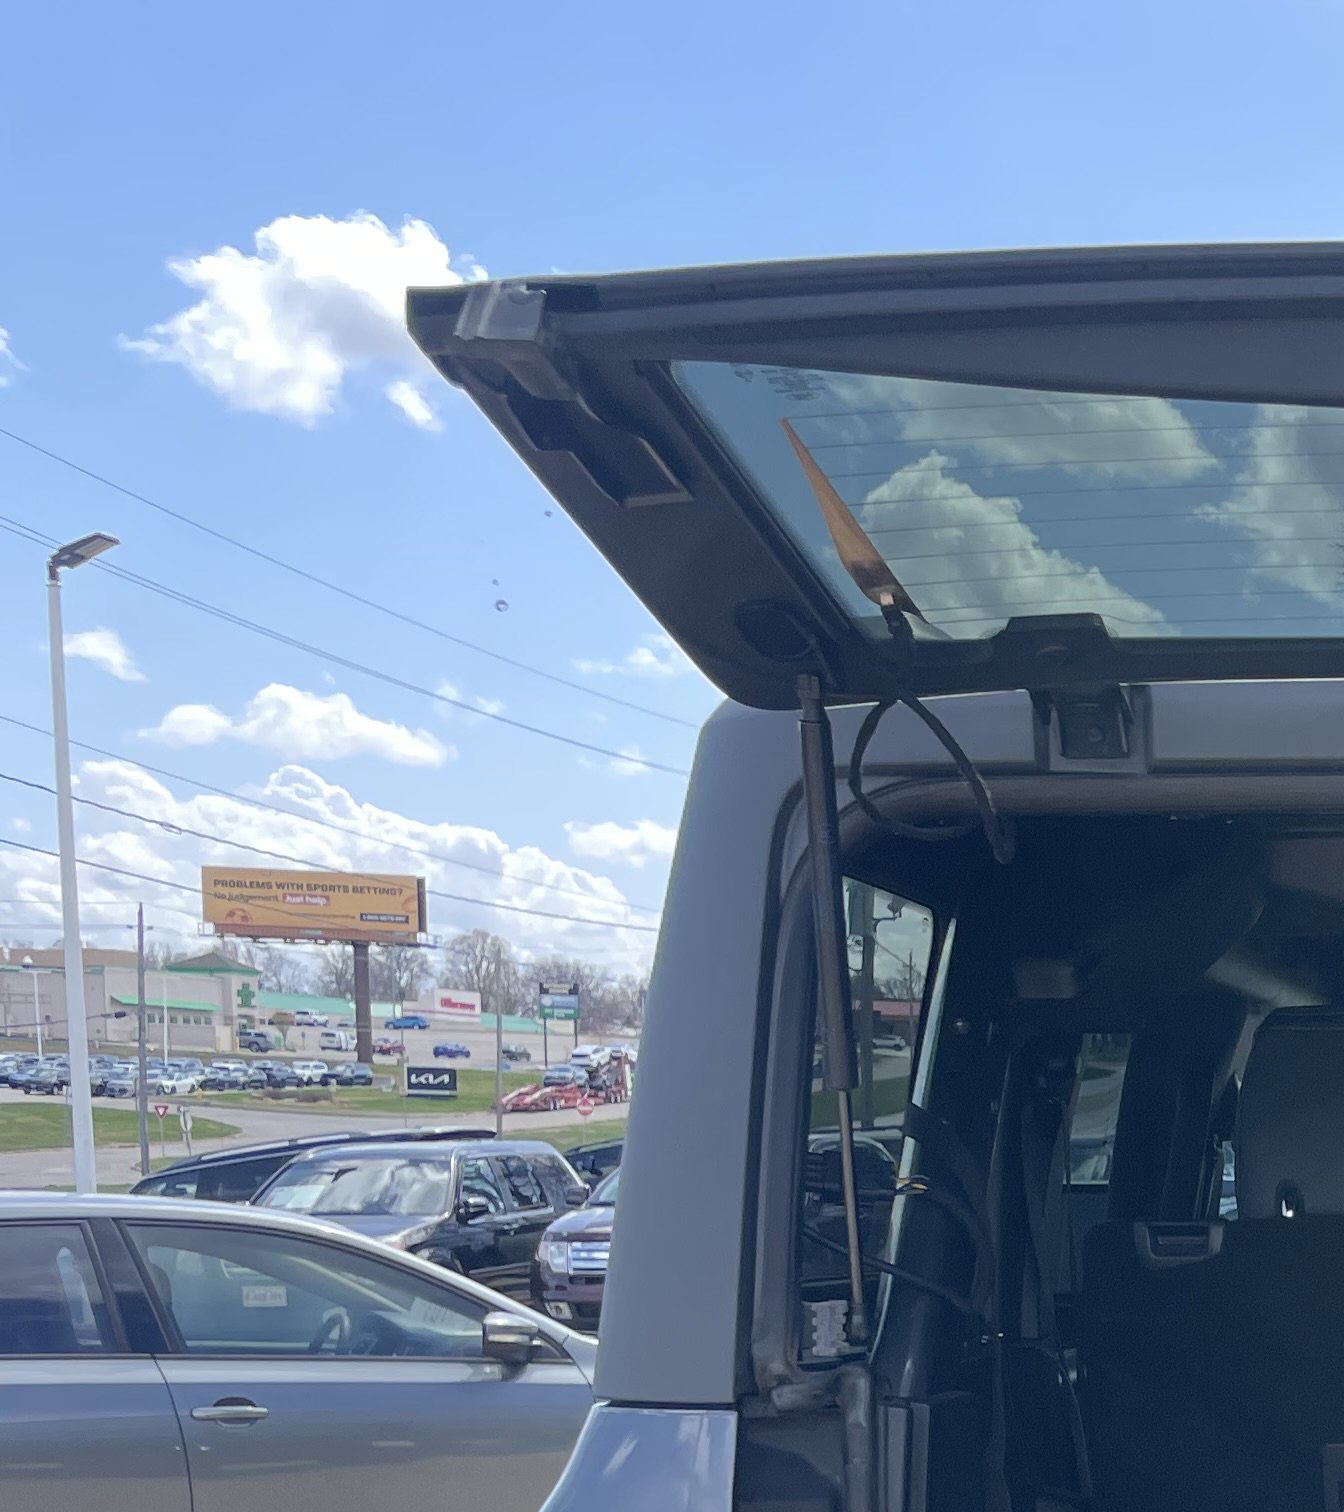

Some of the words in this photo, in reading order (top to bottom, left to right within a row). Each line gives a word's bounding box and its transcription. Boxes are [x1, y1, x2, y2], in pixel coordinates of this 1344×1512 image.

[214, 879, 273, 890] PROBLEMS
[275, 881, 304, 891] WITH
[306, 883, 350, 893] SPORTS
[352, 885, 403, 897] BETTING?
[286, 894, 304, 905] Just
[305, 896, 327, 907] help
